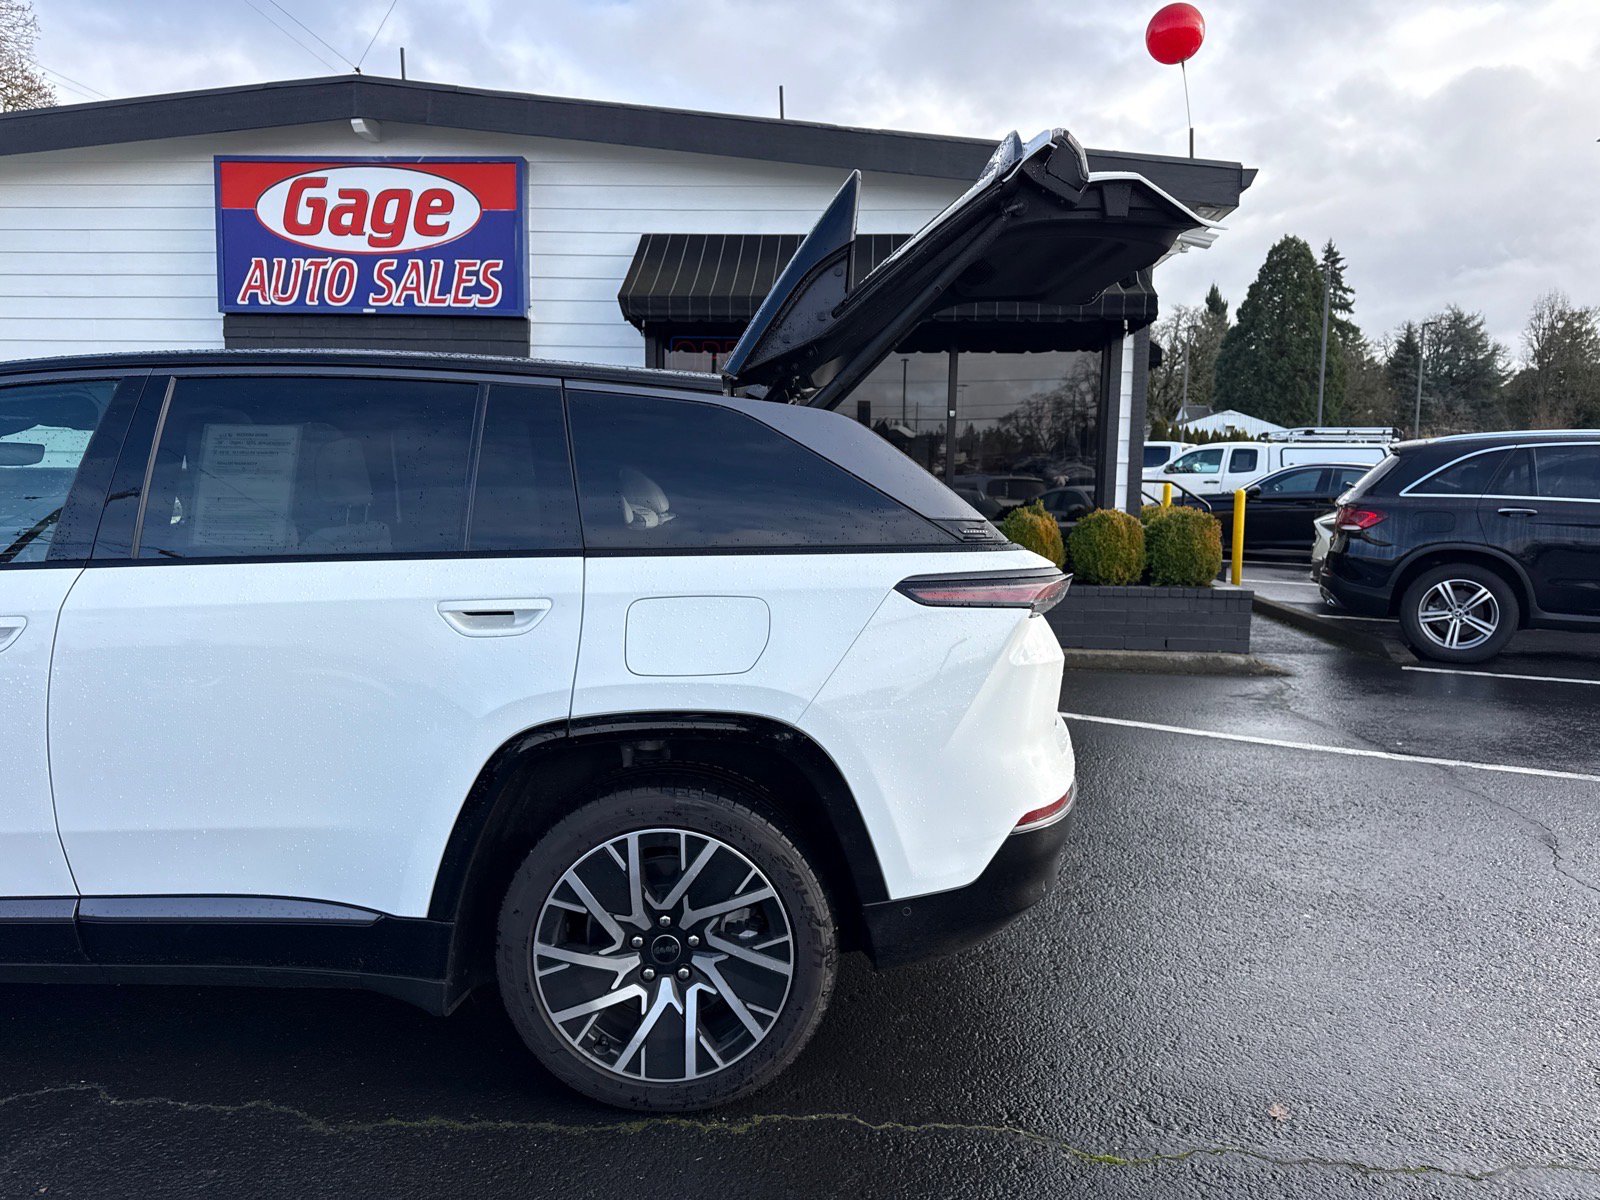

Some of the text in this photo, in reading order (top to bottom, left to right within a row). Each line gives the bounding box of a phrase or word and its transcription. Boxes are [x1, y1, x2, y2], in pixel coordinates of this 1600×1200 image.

[283, 176, 455, 248] Gage
[237, 257, 504, 307] AUTO SALES
